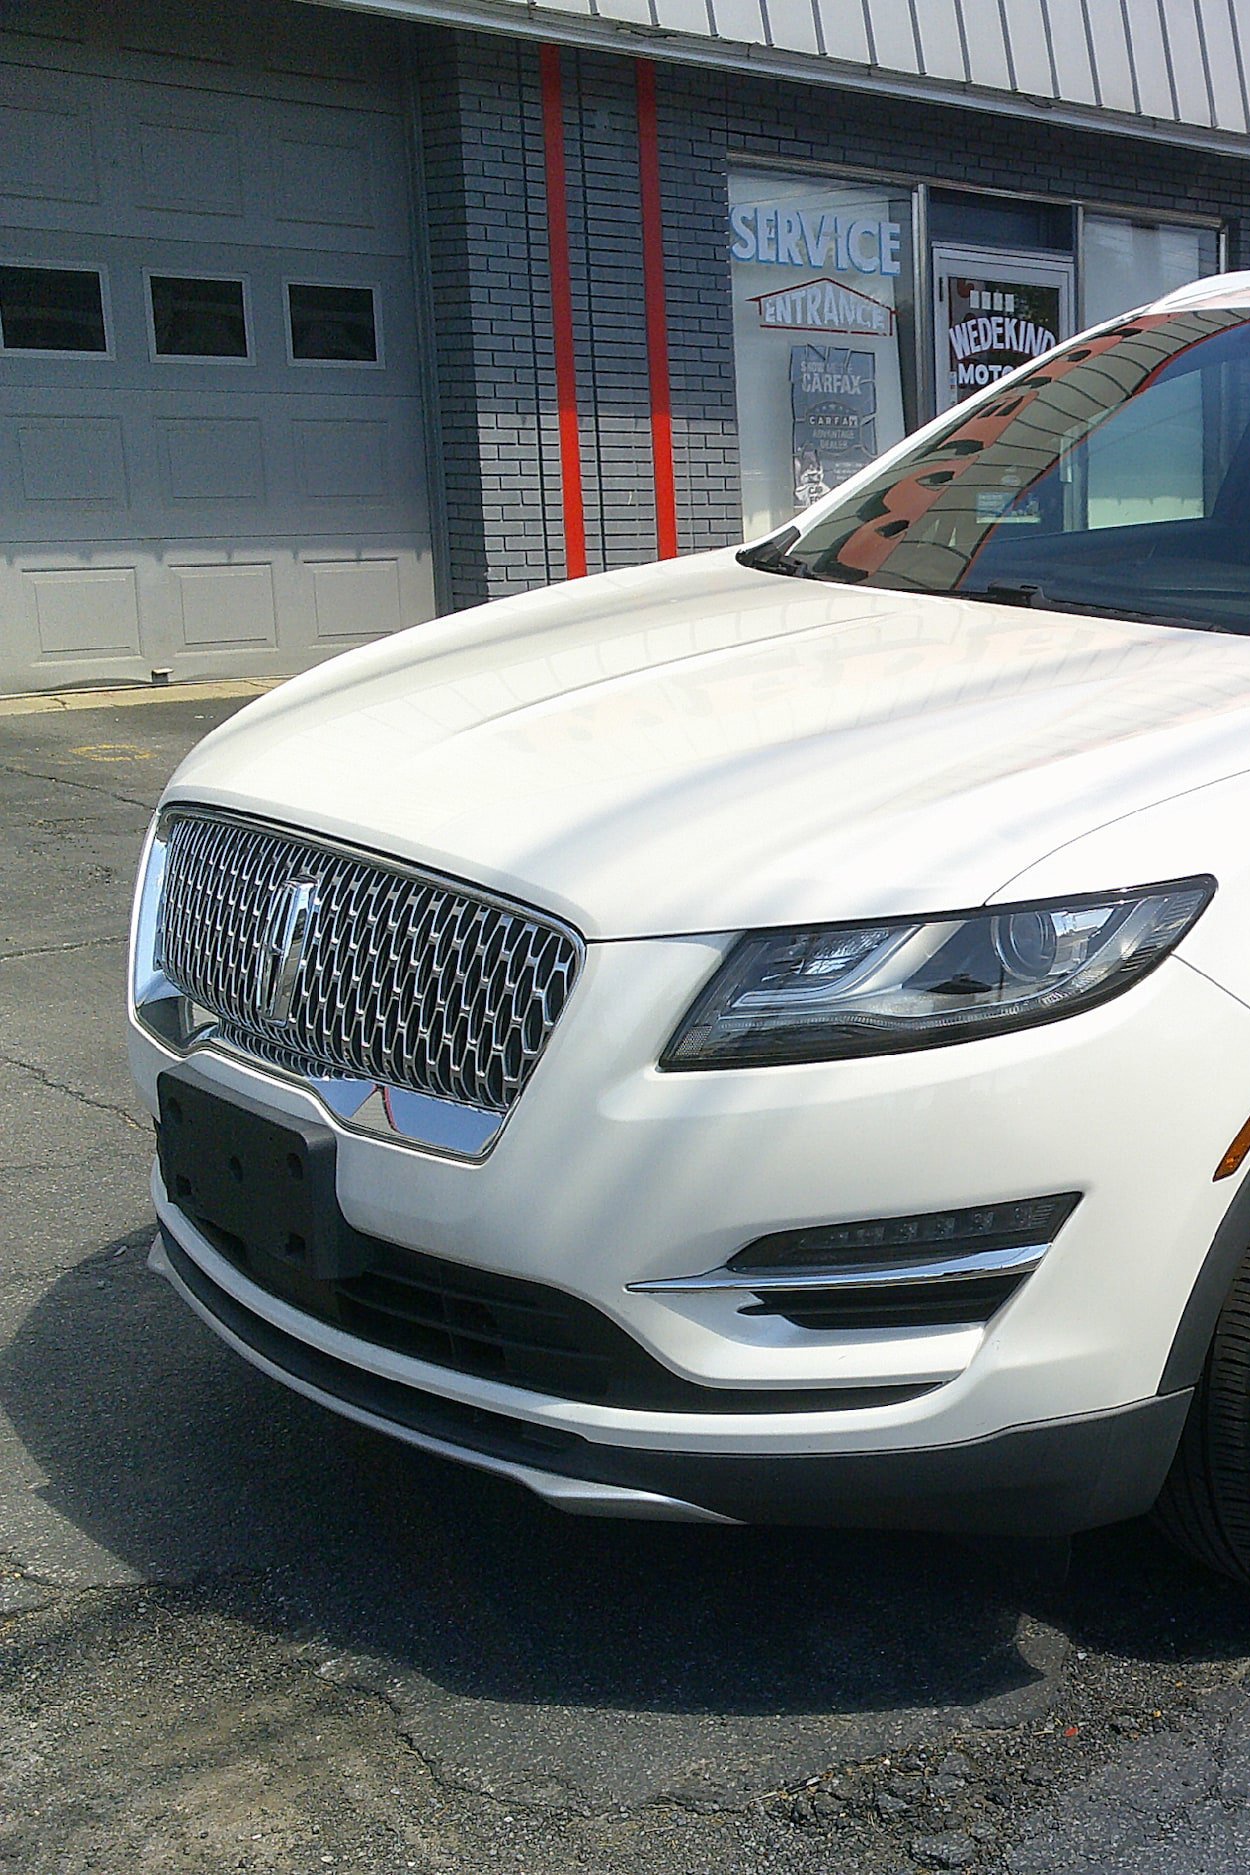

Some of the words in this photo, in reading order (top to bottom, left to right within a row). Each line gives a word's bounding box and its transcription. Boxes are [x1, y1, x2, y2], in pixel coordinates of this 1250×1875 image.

[730, 205, 901, 276] SERVICE
[765, 283, 885, 329] ENTRANCE
[949, 316, 1056, 360] WEDEKIND
[801, 372, 861, 395] CARFAX
